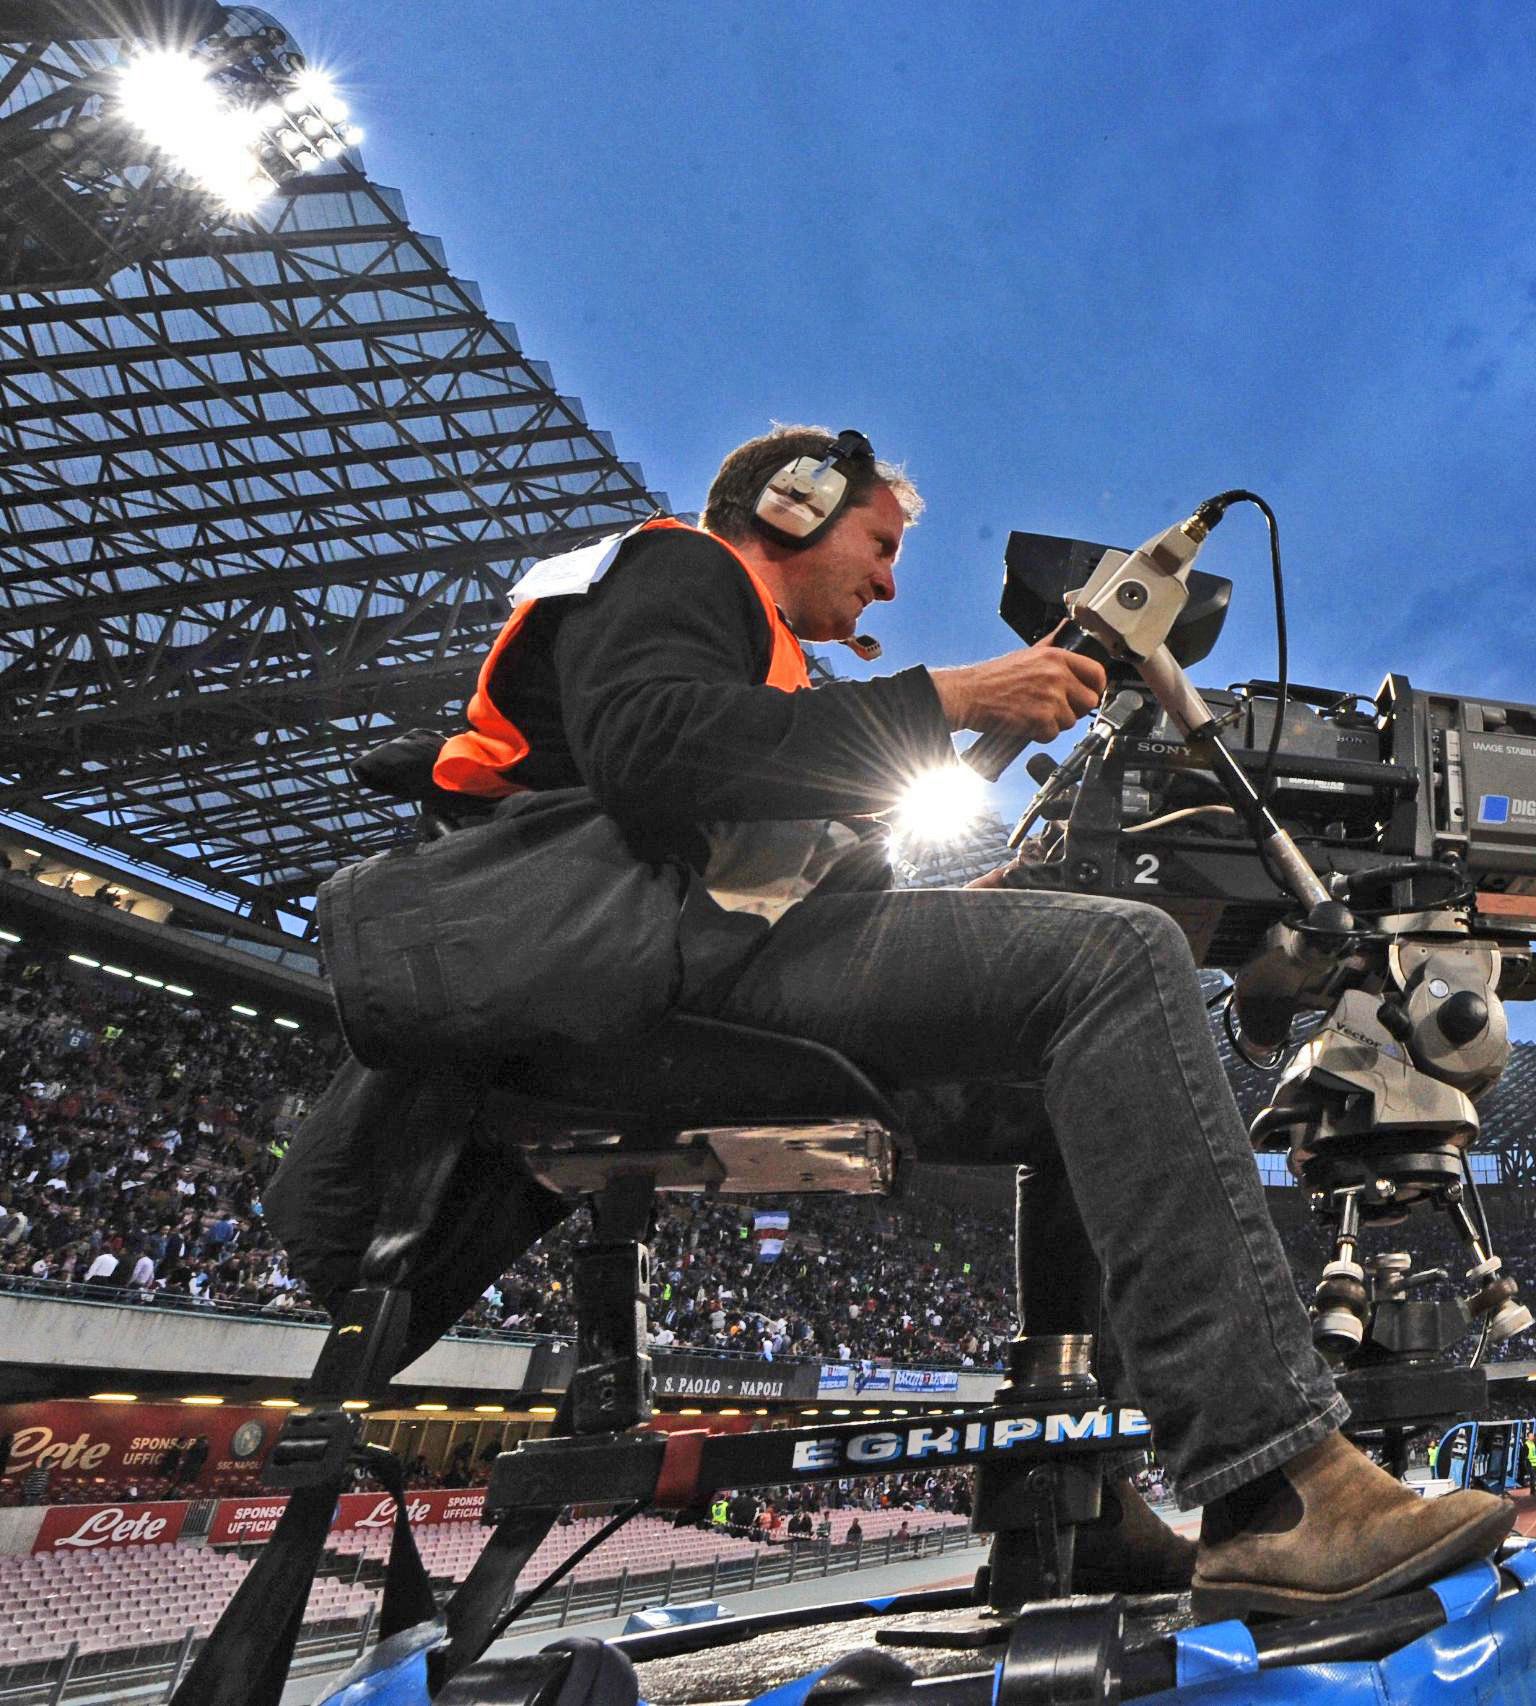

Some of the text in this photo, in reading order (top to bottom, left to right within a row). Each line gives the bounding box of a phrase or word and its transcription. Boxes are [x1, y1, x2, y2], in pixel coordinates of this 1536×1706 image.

[1137, 742, 1191, 756] SONY
[1472, 742, 1504, 754] IMAGE
[1134, 853, 1160, 884] 2
[1337, 1022, 1382, 1048] Vector
[664, 1376, 675, 1393] S.
[678, 1377, 720, 1394] PAOLO
[739, 1380, 783, 1397] NAPOLI
[792, 1407, 1152, 1471] EGRIPME
[448, 1496, 485, 1507] SPONSO
[234, 1506, 285, 1519] SPONSO
[54, 1507, 167, 1547] Lete
